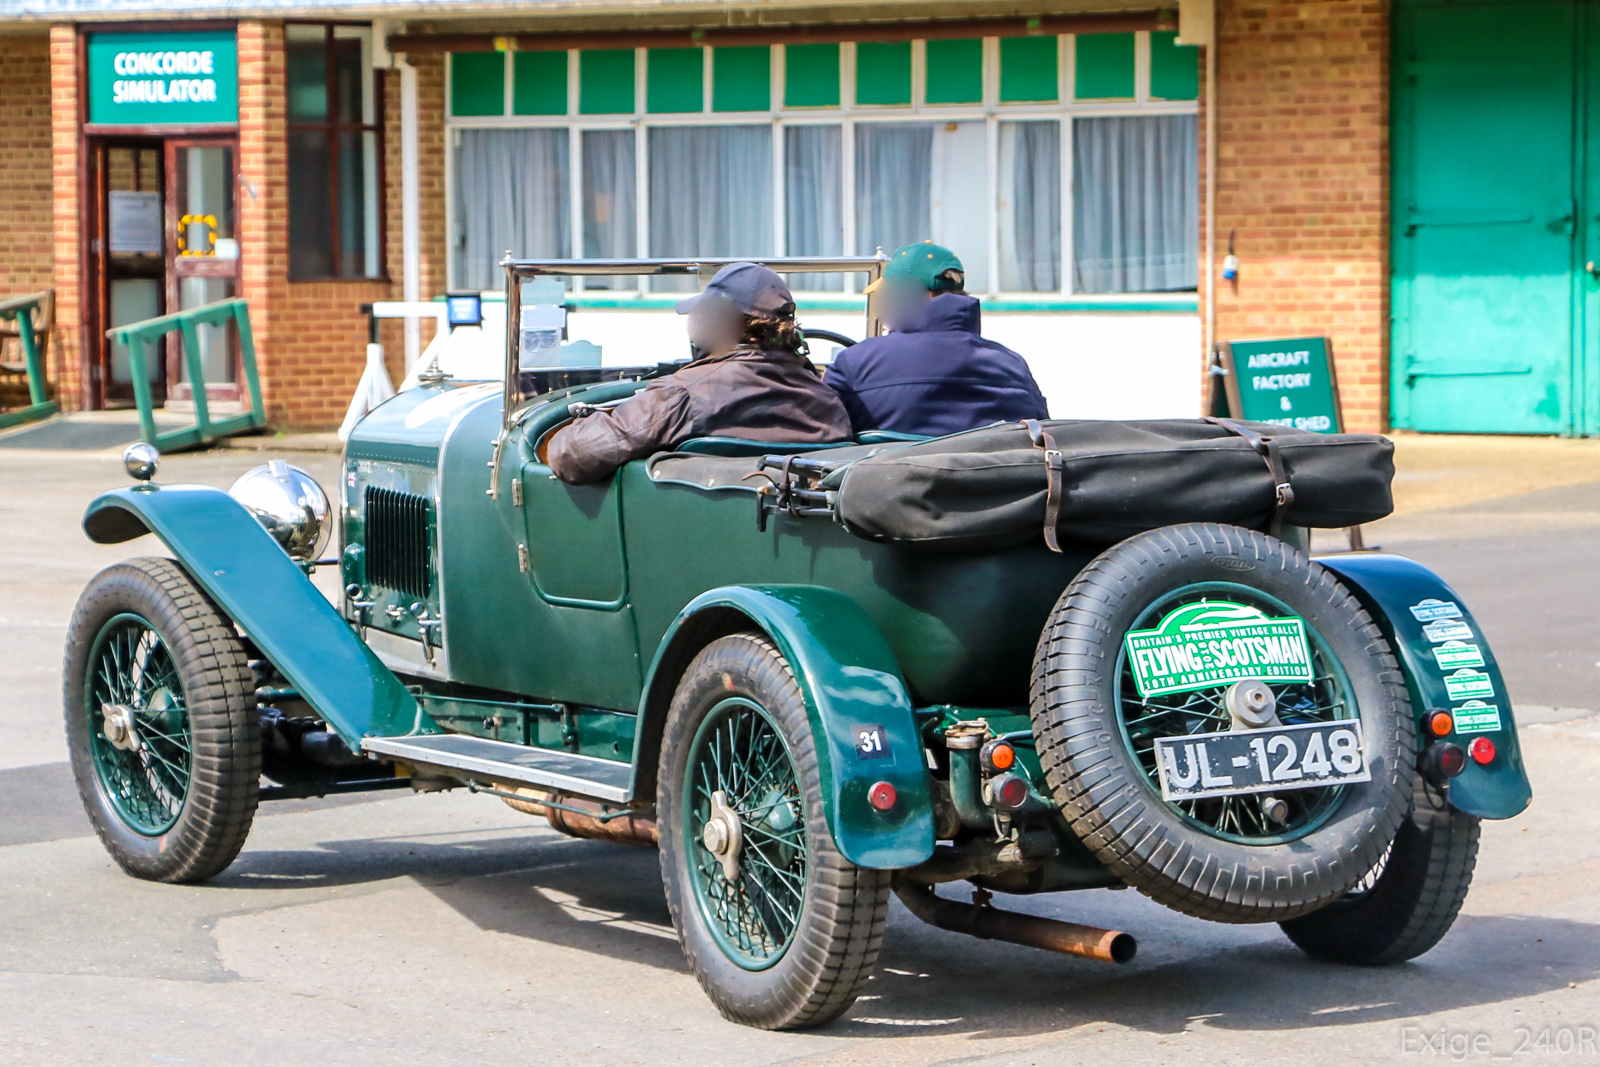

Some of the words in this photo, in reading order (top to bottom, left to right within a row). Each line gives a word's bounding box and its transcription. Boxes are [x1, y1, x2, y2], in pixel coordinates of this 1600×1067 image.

[113, 51, 214, 76] CONCORDE
[112, 78, 217, 104] SIMULATOR
[1248, 350, 1310, 369] AIRCRAFT
[1252, 372, 1312, 391] FACTORY
[1280, 396, 1293, 411] &
[1294, 415, 1332, 431] SHED
[1133, 635, 1183, 649] BRITAIN'S
[1185, 629, 1228, 642] PREMIER
[1229, 626, 1270, 637] VINTAGE
[1271, 624, 1299, 635] RALLY
[1135, 642, 1205, 679] FLYING
[1197, 641, 1215, 669] 2018
[1207, 636, 1306, 668] SCOTSMAN
[1144, 674, 1176, 690] 10TH
[1180, 666, 1262, 685] ANNIVERSARY
[1267, 664, 1308, 676] EDITION
[859, 730, 882, 753] 31
